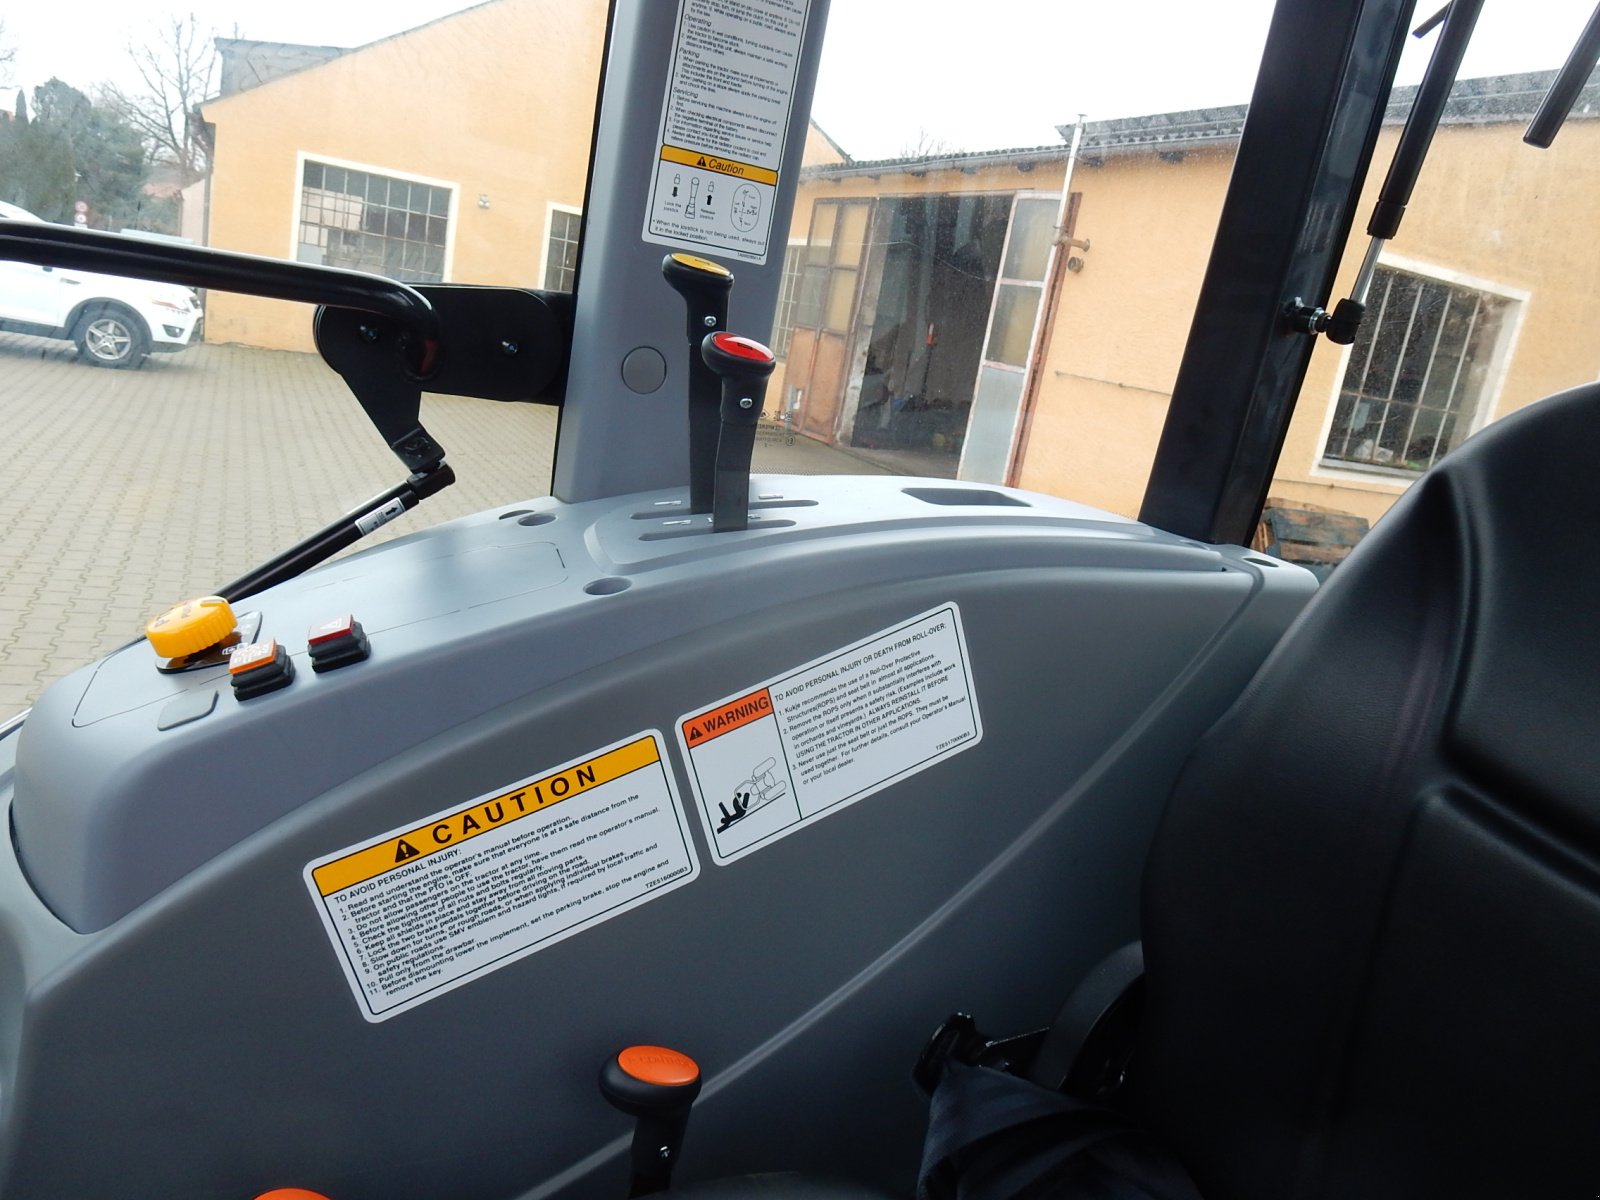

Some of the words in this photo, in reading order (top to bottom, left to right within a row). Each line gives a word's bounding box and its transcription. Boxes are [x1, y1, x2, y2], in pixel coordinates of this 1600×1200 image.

[683, 12, 712, 27] Operating
[678, 46, 700, 58] Parking
[672, 86, 699, 98] Servicing
[709, 159, 744, 176] Caution
[672, 229, 688, 237] locked
[688, 233, 707, 242] position.
[680, 224, 698, 233] joystick
[713, 231, 727, 239] being
[741, 237, 756, 245] always
[774, 693, 783, 701] TO
[785, 684, 804, 698] AVOID
[804, 669, 839, 688] PERSONAL
[840, 658, 861, 673] INJURY
[862, 654, 872, 663] OR
[873, 645, 893, 659] DEATH
[894, 637, 911, 649] FROM
[911, 622, 946, 642] ROLL-OVER:
[784, 703, 800, 713] Kukje
[801, 687, 837, 705] recommends
[869, 661, 893, 675] Roll-Over
[894, 650, 920, 664] Protective
[786, 696, 835, 722] Structures(ROPS)
[836, 691, 846, 700] and
[847, 686, 859, 695] seat
[859, 681, 870, 690] belt
[878, 670, 895, 682] almost
[903, 653, 934, 671] applications.
[703, 696, 769, 734] WARNING
[789, 718, 811, 731] Remove
[822, 704, 839, 716] ROPS
[839, 700, 851, 709] only
[852, 693, 867, 703] when
[872, 676, 905, 694] substantially
[905, 665, 930, 679] interferes
[795, 745, 814, 758] USING
[814, 740, 826, 749] THE
[826, 727, 854, 743] TRACTOR
[861, 715, 880, 728] OTHER
[881, 697, 920, 719] APPLICATIONS.
[432, 765, 596, 844] CAUTION
[333, 893, 347, 903] TO
[349, 882, 376, 898] AVOID
[377, 863, 426, 886] PERSONAL
[427, 848, 461, 866] INJURY:
[347, 898, 368, 910] Read
[369, 891, 384, 901] and
[385, 873, 429, 895] understand
[429, 868, 442, 876] the
[444, 852, 482, 871] operator's
[483, 839, 510, 855] manual
[511, 830, 534, 843] before
[536, 815, 572, 833] operation.
[350, 903, 376, 917] Before
[377, 890, 407, 906] starting
[408, 885, 421, 893] the
[422, 873, 451, 887] engine,
[450, 864, 471, 875] make
[473, 856, 490, 866] sure
[491, 849, 506, 859] that
[507, 836, 540, 852] everyone
[564, 819, 579, 828] safe
[580, 806, 609, 821] distance
[610, 799, 626, 809] from
[354, 909, 380, 923] tractor
[382, 901, 397, 912] and
[397, 895, 413, 905] that
[414, 890, 427, 898] the
[428, 882, 444, 893] PTO
[454, 870, 472, 881] OFF.
[361, 930, 385, 944] Check
[387, 925, 399, 933] the
[400, 910, 436, 927] tightness
[437, 903, 445, 912] of
[447, 900, 456, 908] all
[456, 893, 474, 903] nuts
[475, 886, 490, 896] and
[490, 878, 509, 889] bolts
[510, 864, 544, 881] regularly.
[367, 945, 386, 957] Lock
[387, 940, 400, 948] the
[401, 934, 415, 942] two
[416, 924, 437, 936] brake
[439, 913, 464, 928] pedals
[465, 899, 495, 915] together
[497, 888, 520, 901] before
[522, 877, 547, 891] driving
[558, 866, 570, 875] the
[571, 858, 589, 870] road.
[369, 916, 382, 925] not
[383, 908, 403, 919] allow
[405, 889, 448, 912] passengers
[474, 867, 498, 881] tractor
[509, 858, 522, 866] any
[523, 851, 542, 860] time.
[377, 963, 399, 976] safety
[401, 944, 445, 966] regulations.
[378, 973, 393, 983] Pull
[395, 966, 410, 976] only
[411, 958, 430, 968] from
[431, 952, 443, 960] the
[445, 938, 476, 954] drawbar.
